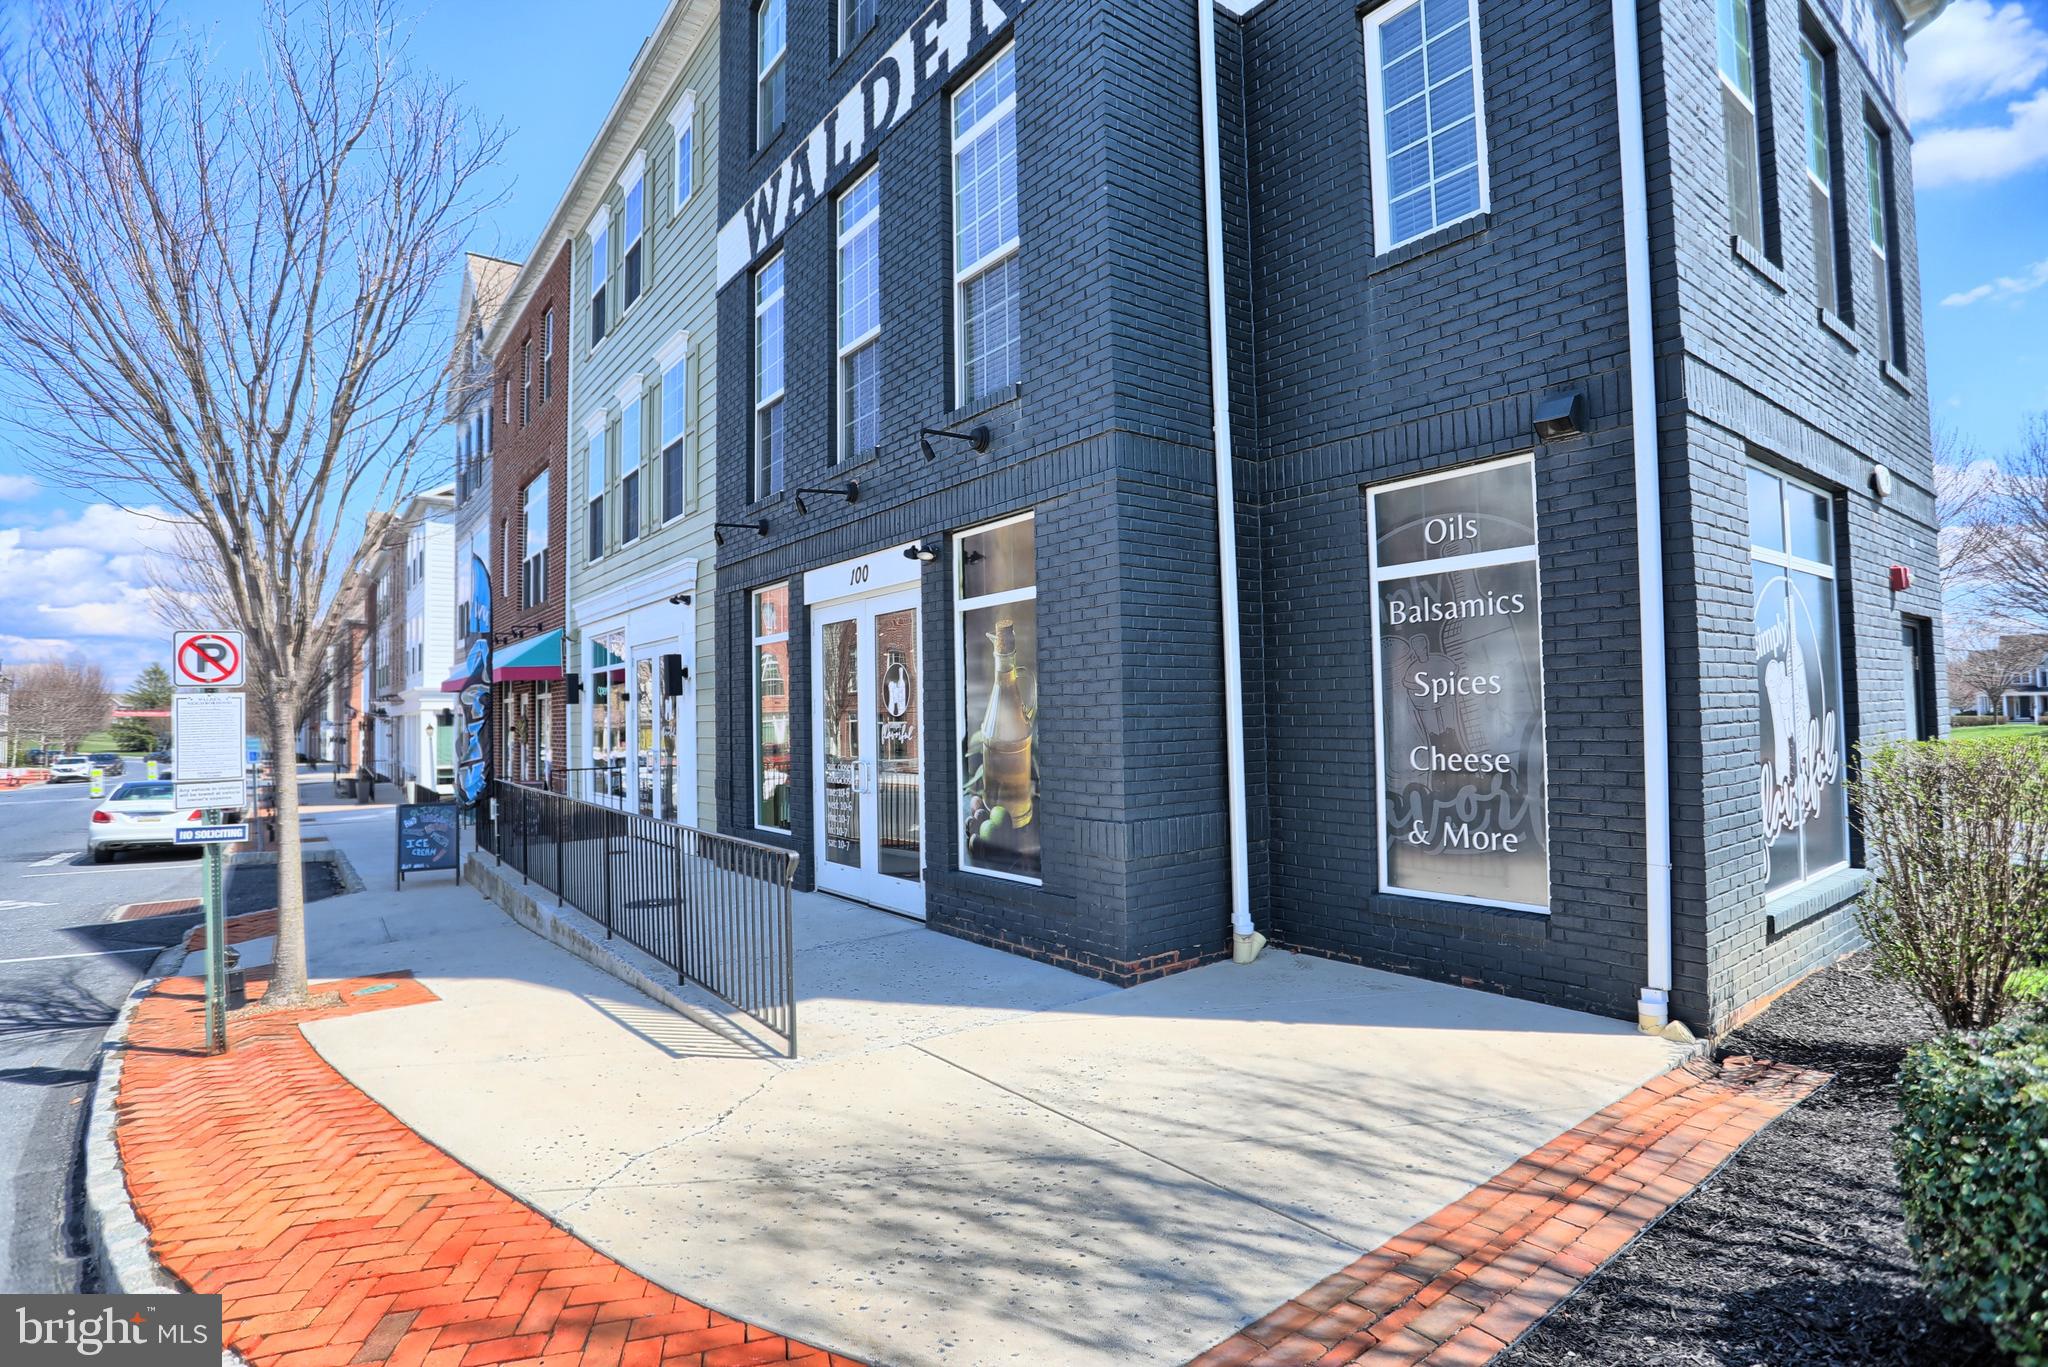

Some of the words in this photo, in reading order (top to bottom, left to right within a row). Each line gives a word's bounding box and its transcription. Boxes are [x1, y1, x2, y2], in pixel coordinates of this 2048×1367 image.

[1424, 514, 1478, 544] Oils
[850, 564, 869, 586] 100
[1390, 590, 1525, 625] Balsamics
[1414, 671, 1502, 703] Spices
[1410, 746, 1511, 773] Cheese
[1761, 709, 1838, 884] lavorful
[180, 830, 194, 840] NO
[194, 828, 243, 839] SOLICITING
[405, 838, 429, 849] ICE
[1408, 819, 1431, 846] &
[1443, 822, 1519, 853] More
[411, 847, 437, 857] CREAM
